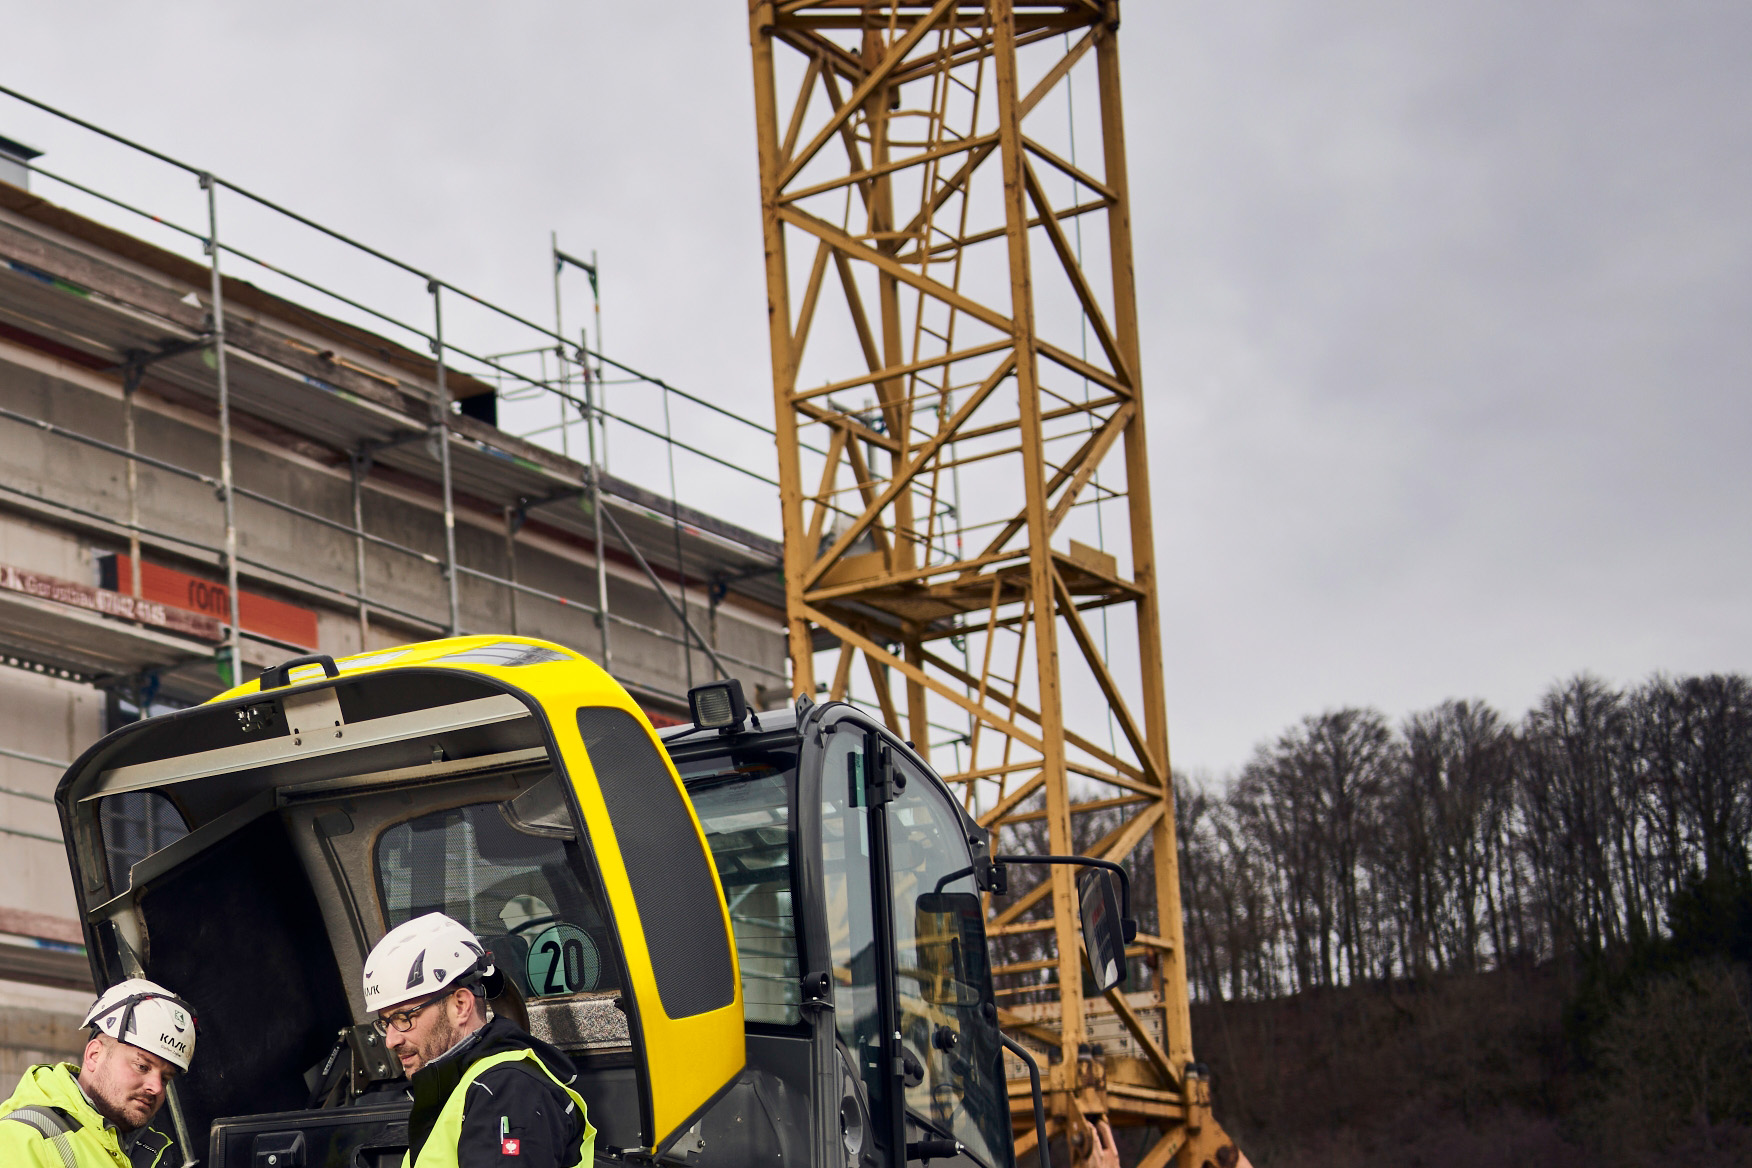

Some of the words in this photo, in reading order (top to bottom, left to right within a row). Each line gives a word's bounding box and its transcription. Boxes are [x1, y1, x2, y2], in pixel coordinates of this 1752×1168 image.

[188, 580, 228, 617] rom
[541, 938, 586, 994] 20
[159, 1032, 186, 1053] KASK
